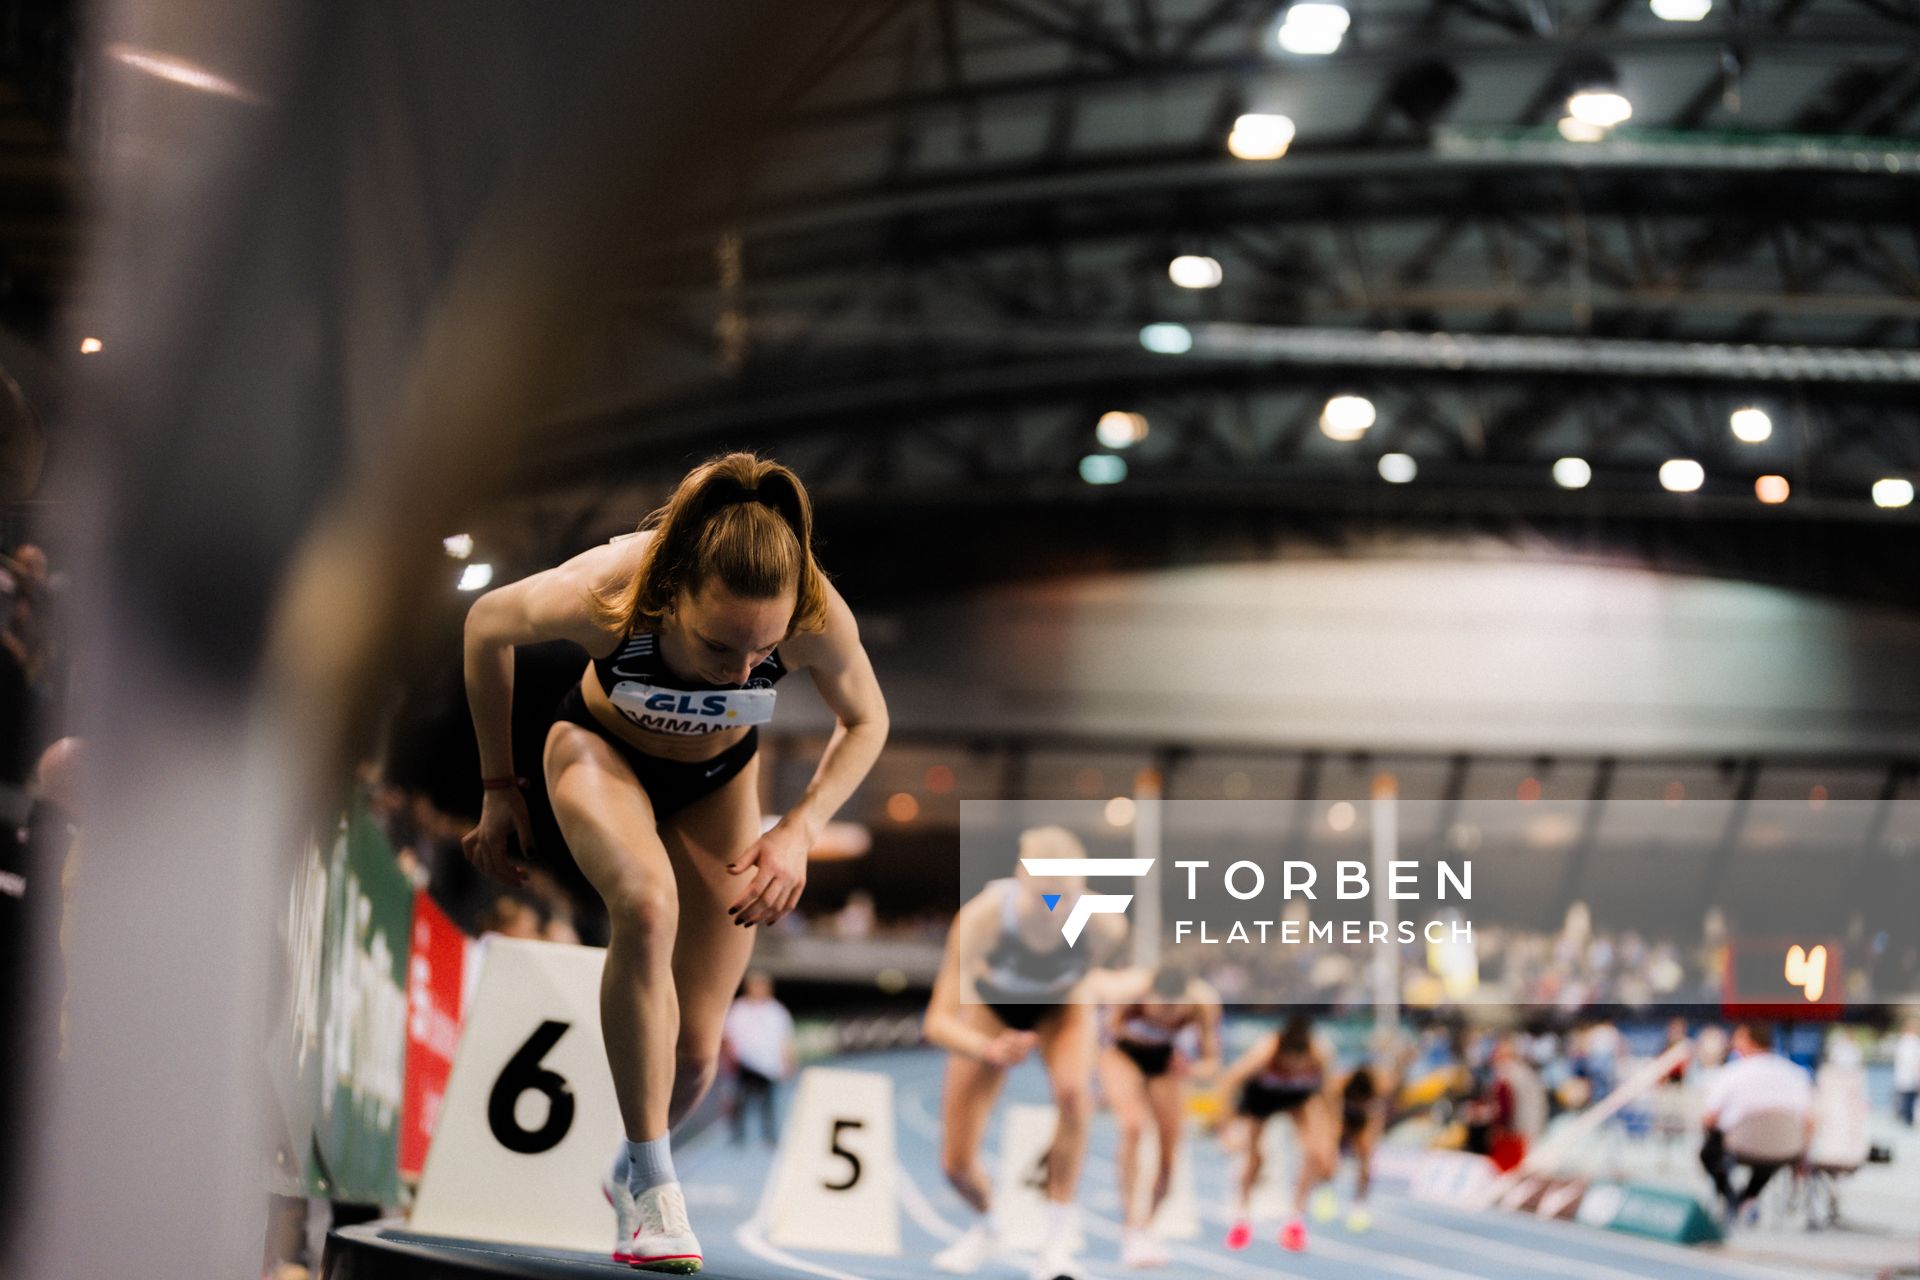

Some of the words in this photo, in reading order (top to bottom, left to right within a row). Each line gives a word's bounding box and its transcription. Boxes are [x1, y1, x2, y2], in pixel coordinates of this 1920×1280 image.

[1784, 944, 1828, 1003] 4
[487, 1019, 577, 1155] 6
[823, 1118, 865, 1192] 5
